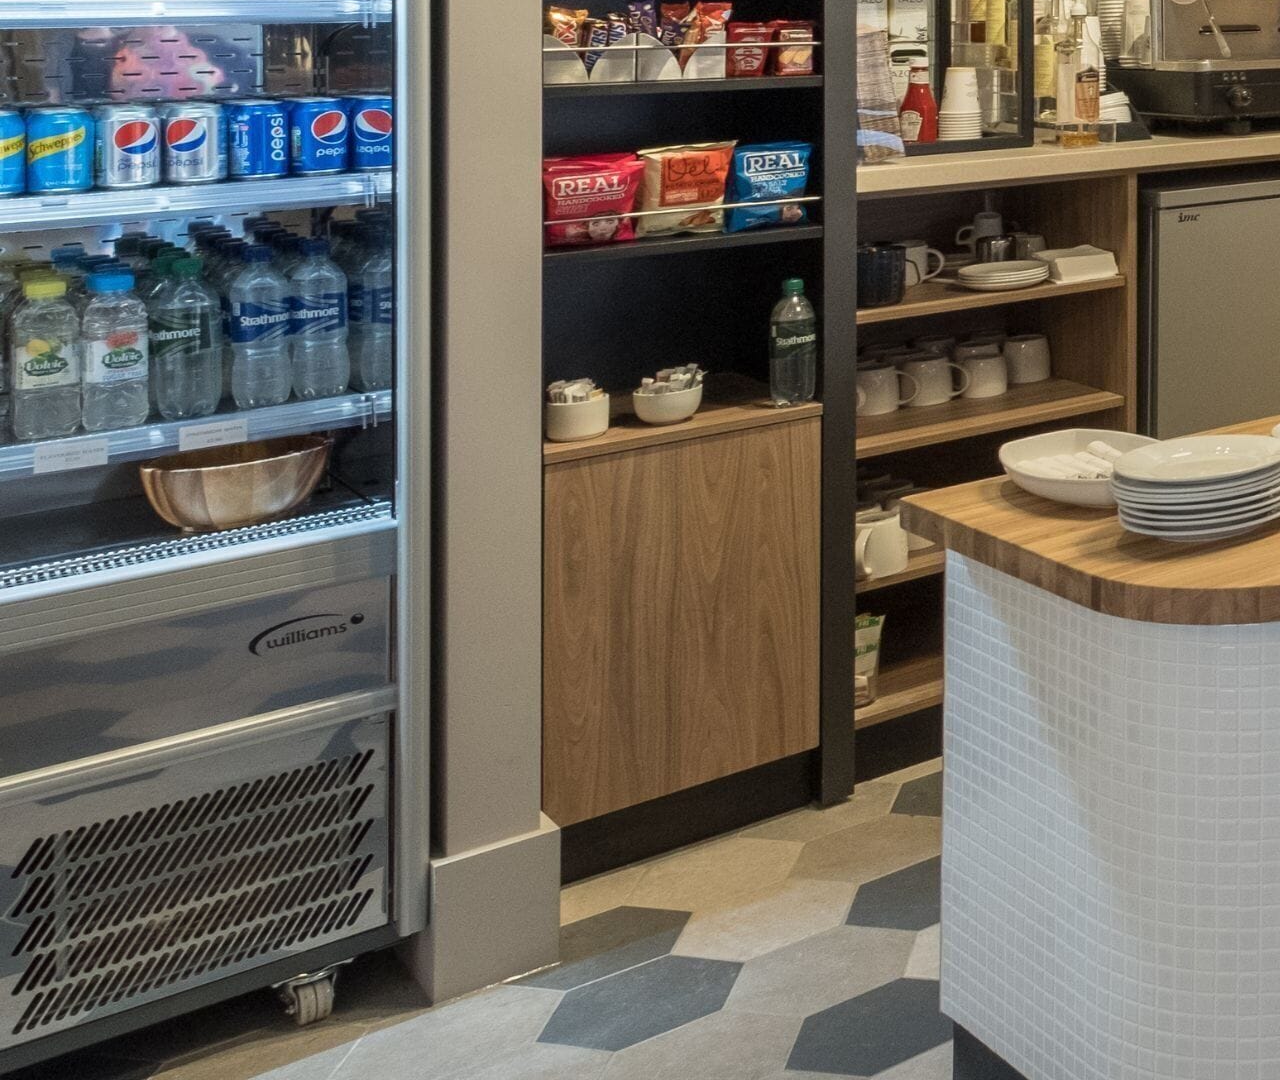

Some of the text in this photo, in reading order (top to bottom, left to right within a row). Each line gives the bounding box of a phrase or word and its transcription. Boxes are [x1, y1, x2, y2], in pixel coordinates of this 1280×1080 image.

[267, 113, 287, 161] pepsi
[750, 153, 803, 172] REAL
[557, 175, 625, 196] REAL
[266, 622, 348, 648] williams
